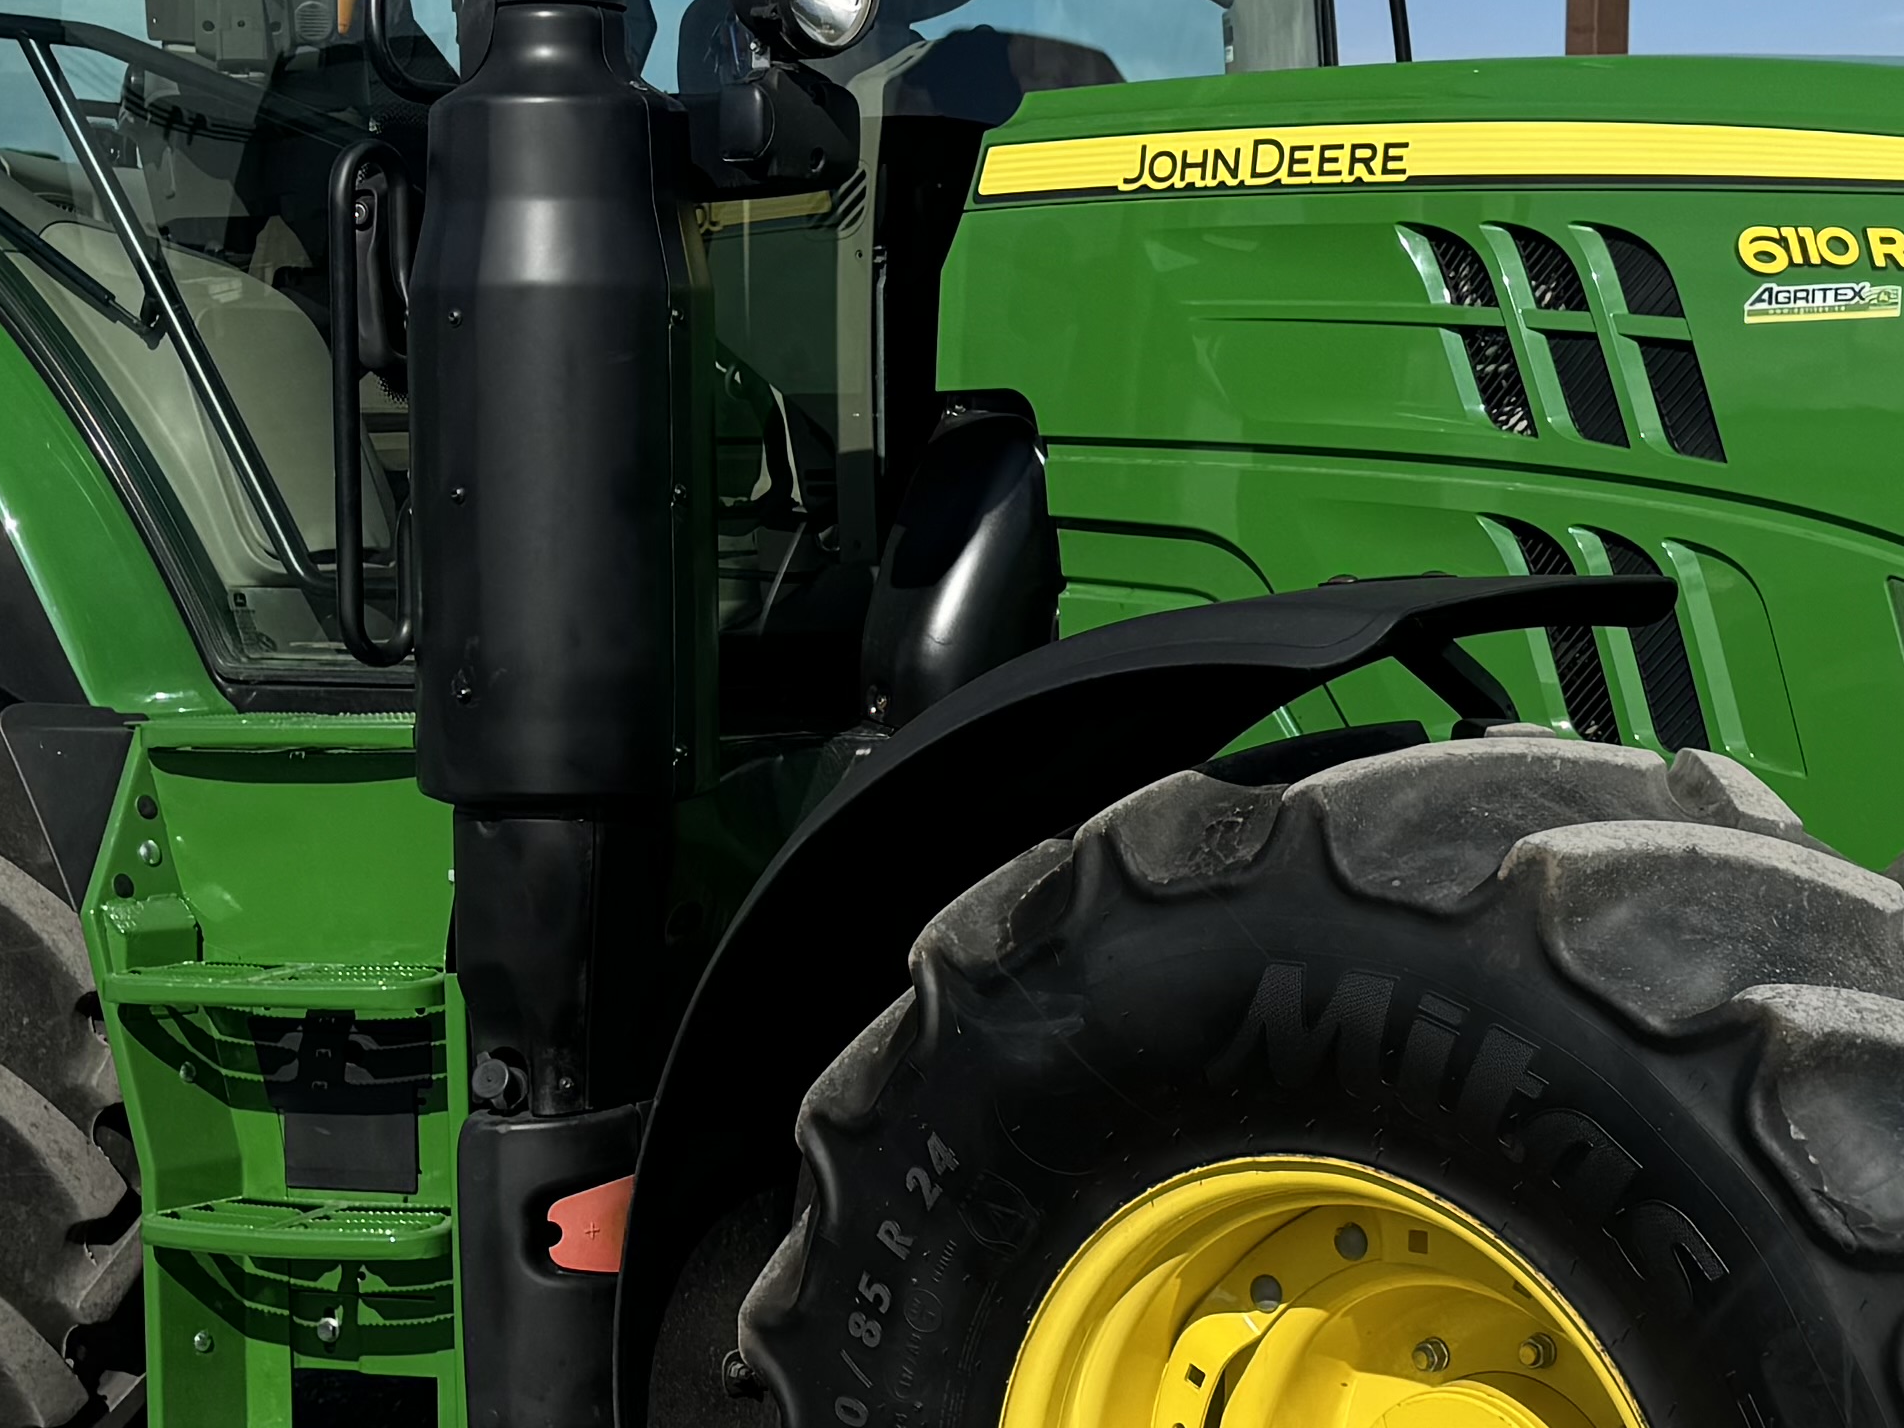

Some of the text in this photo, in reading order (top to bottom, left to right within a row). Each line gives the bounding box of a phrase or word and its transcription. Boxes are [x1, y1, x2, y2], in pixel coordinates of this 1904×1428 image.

[1122, 137, 1410, 185] JOHN DEERE
[1737, 225, 1861, 275] 6110
[1748, 284, 1867, 307] AGRITEX
[1202, 959, 1731, 1307] Mitas
[876, 1219, 915, 1261] R
[905, 1130, 960, 1212] 24
